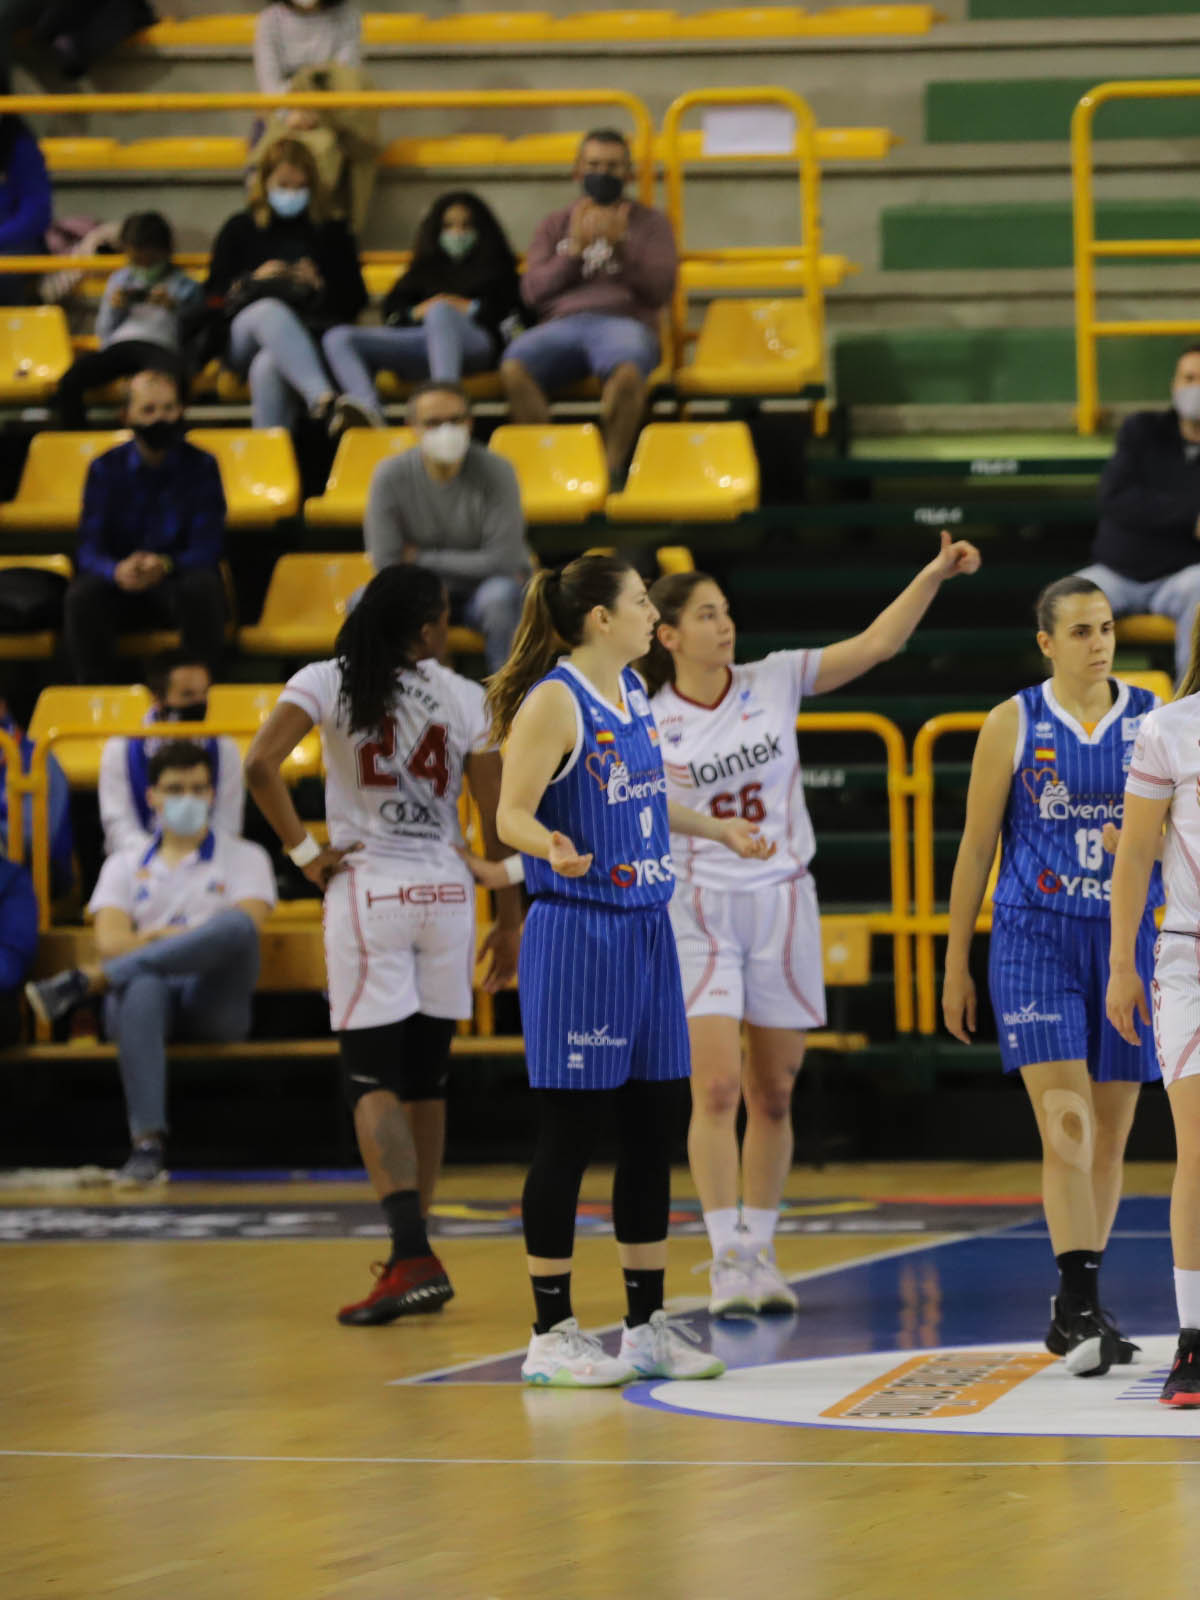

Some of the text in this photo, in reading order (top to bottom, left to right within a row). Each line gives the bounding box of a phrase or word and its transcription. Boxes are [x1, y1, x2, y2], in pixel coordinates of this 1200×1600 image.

[356, 713, 449, 798] 24
[688, 733, 783, 788] lointek
[1075, 828, 1104, 871] 13
[366, 883, 466, 909] HGB
